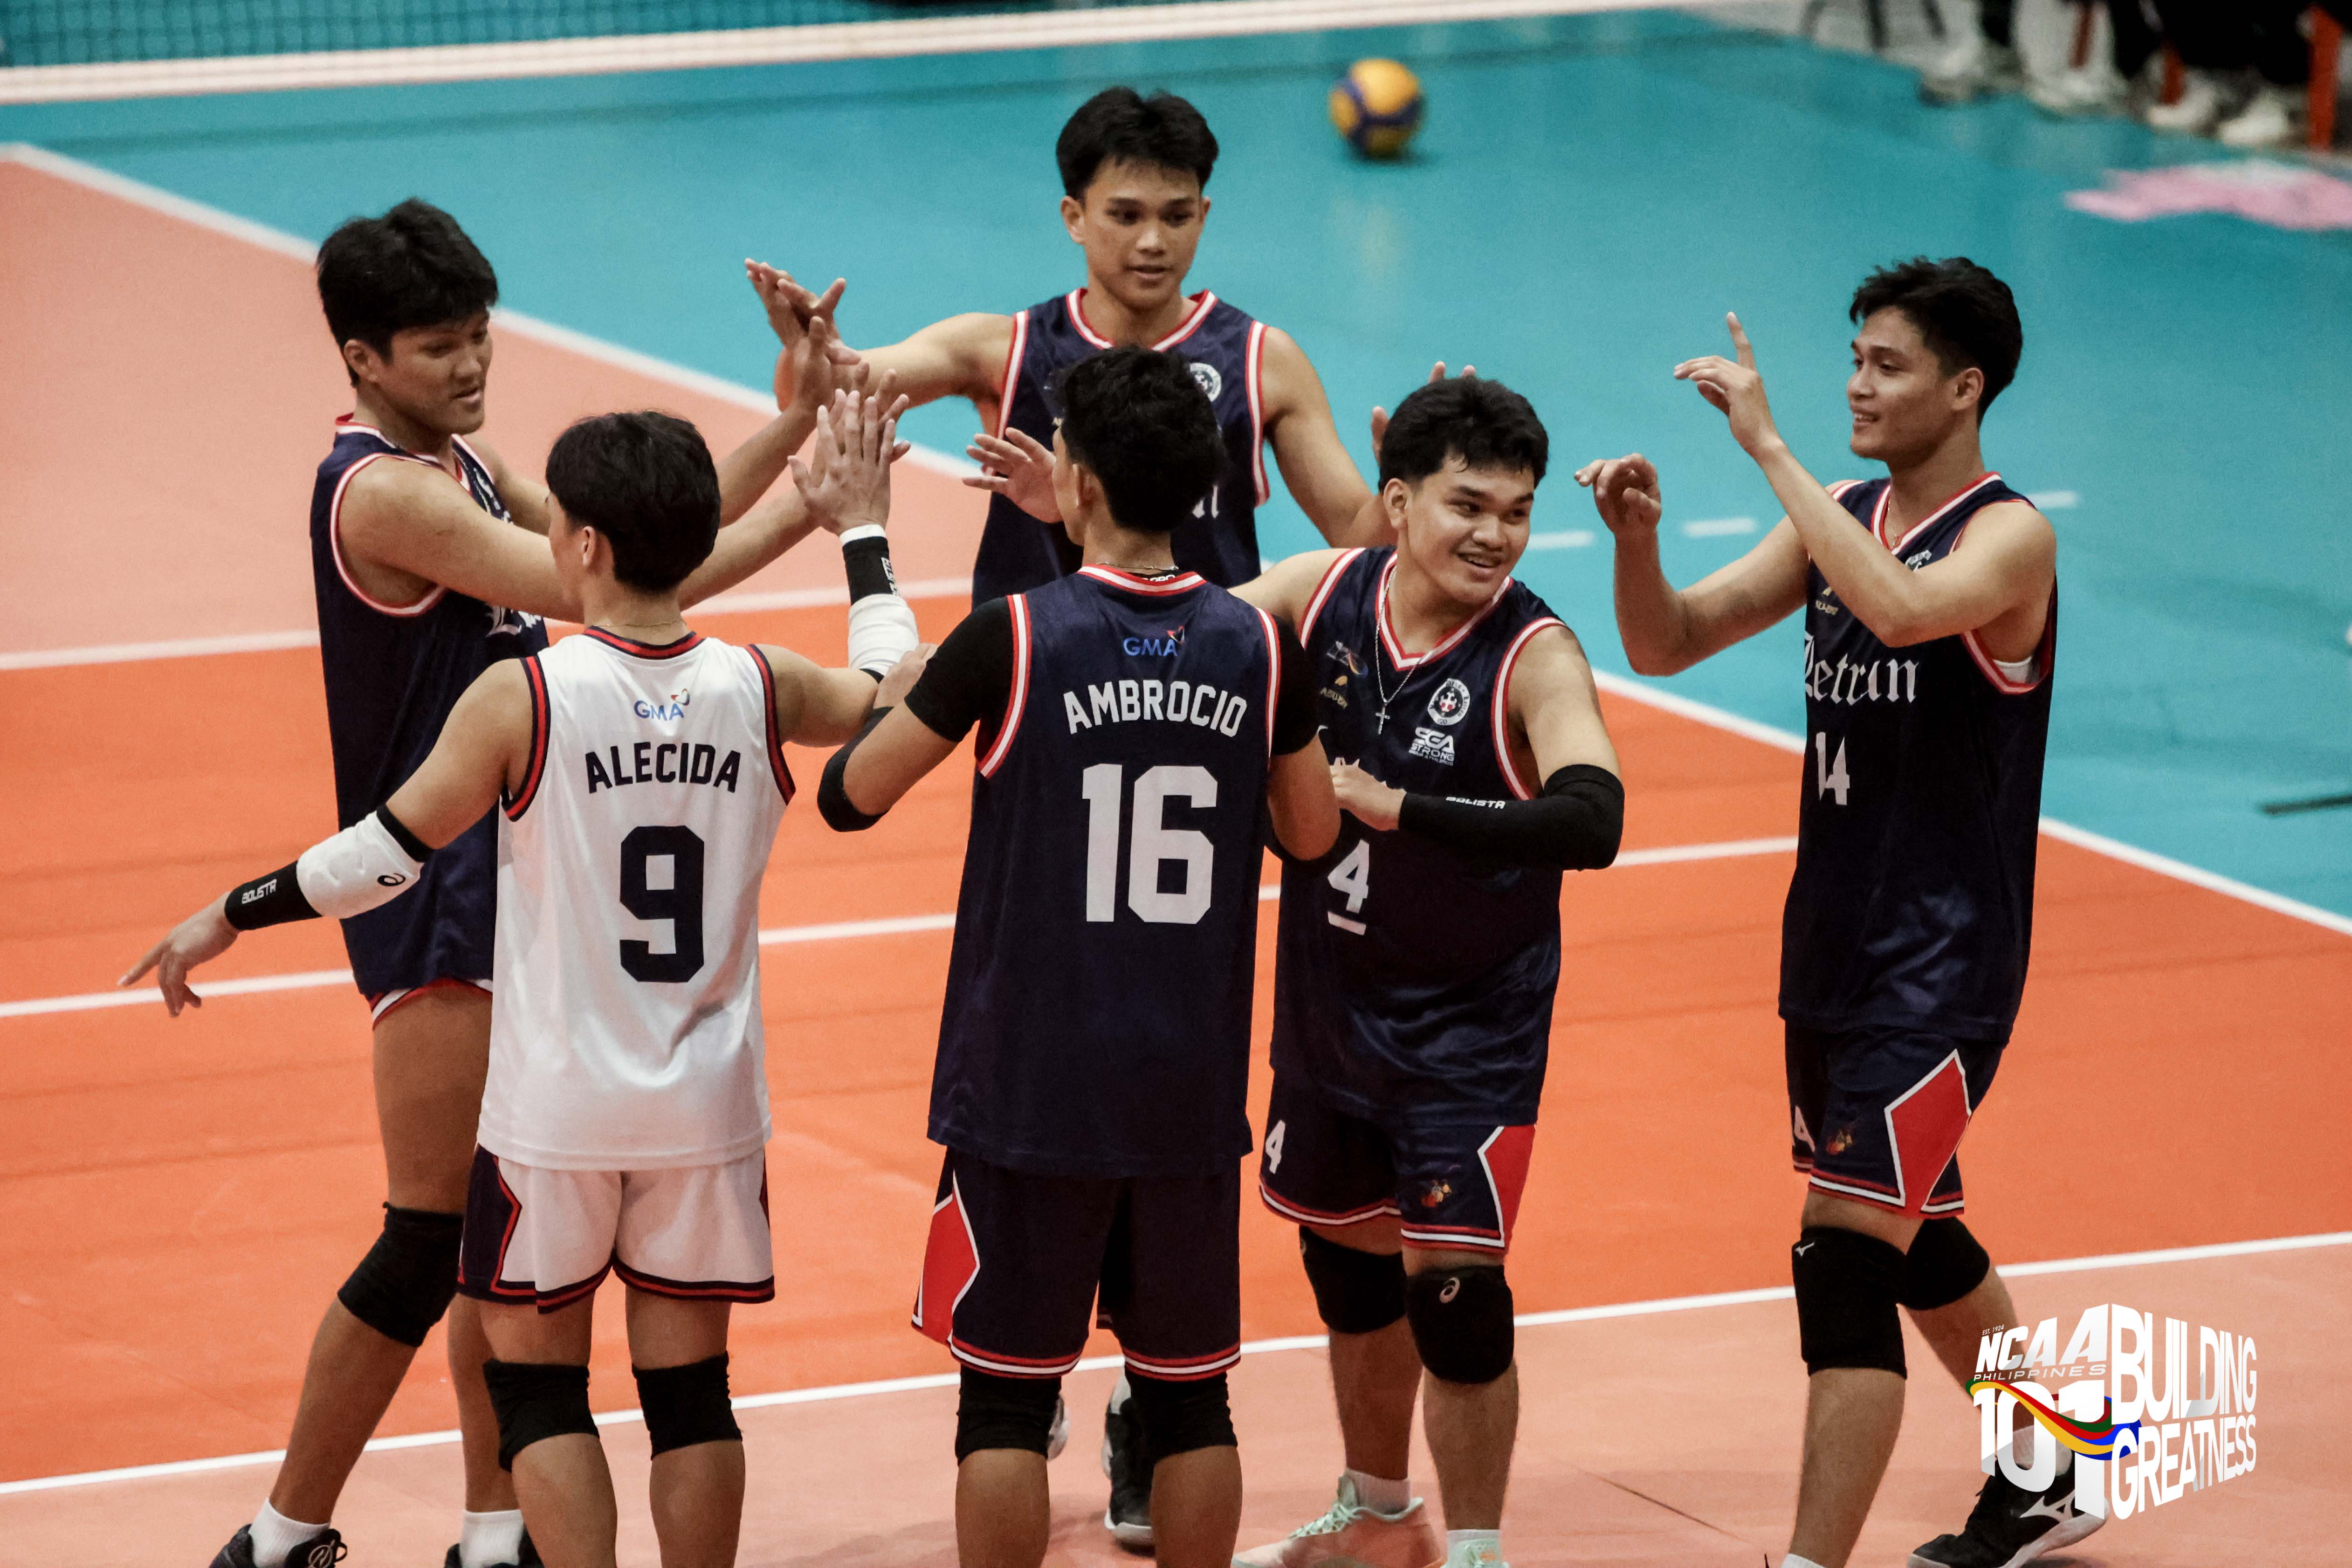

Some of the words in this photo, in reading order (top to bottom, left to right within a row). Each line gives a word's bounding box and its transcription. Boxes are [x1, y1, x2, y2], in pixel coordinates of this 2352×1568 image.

[1123, 638, 1177, 657] GMA
[633, 700, 684, 721] GMA
[1063, 680, 1247, 737] AMBROCIO
[585, 742, 741, 794] ALECIDA
[1410, 742, 1455, 762] STRONG
[1816, 731, 1850, 806] 14
[1082, 763, 1218, 924] 16
[241, 879, 277, 904] BOLISTA
[1327, 839, 1370, 914] 4
[619, 825, 705, 983] 9
[1265, 1120, 1286, 1174] 4
